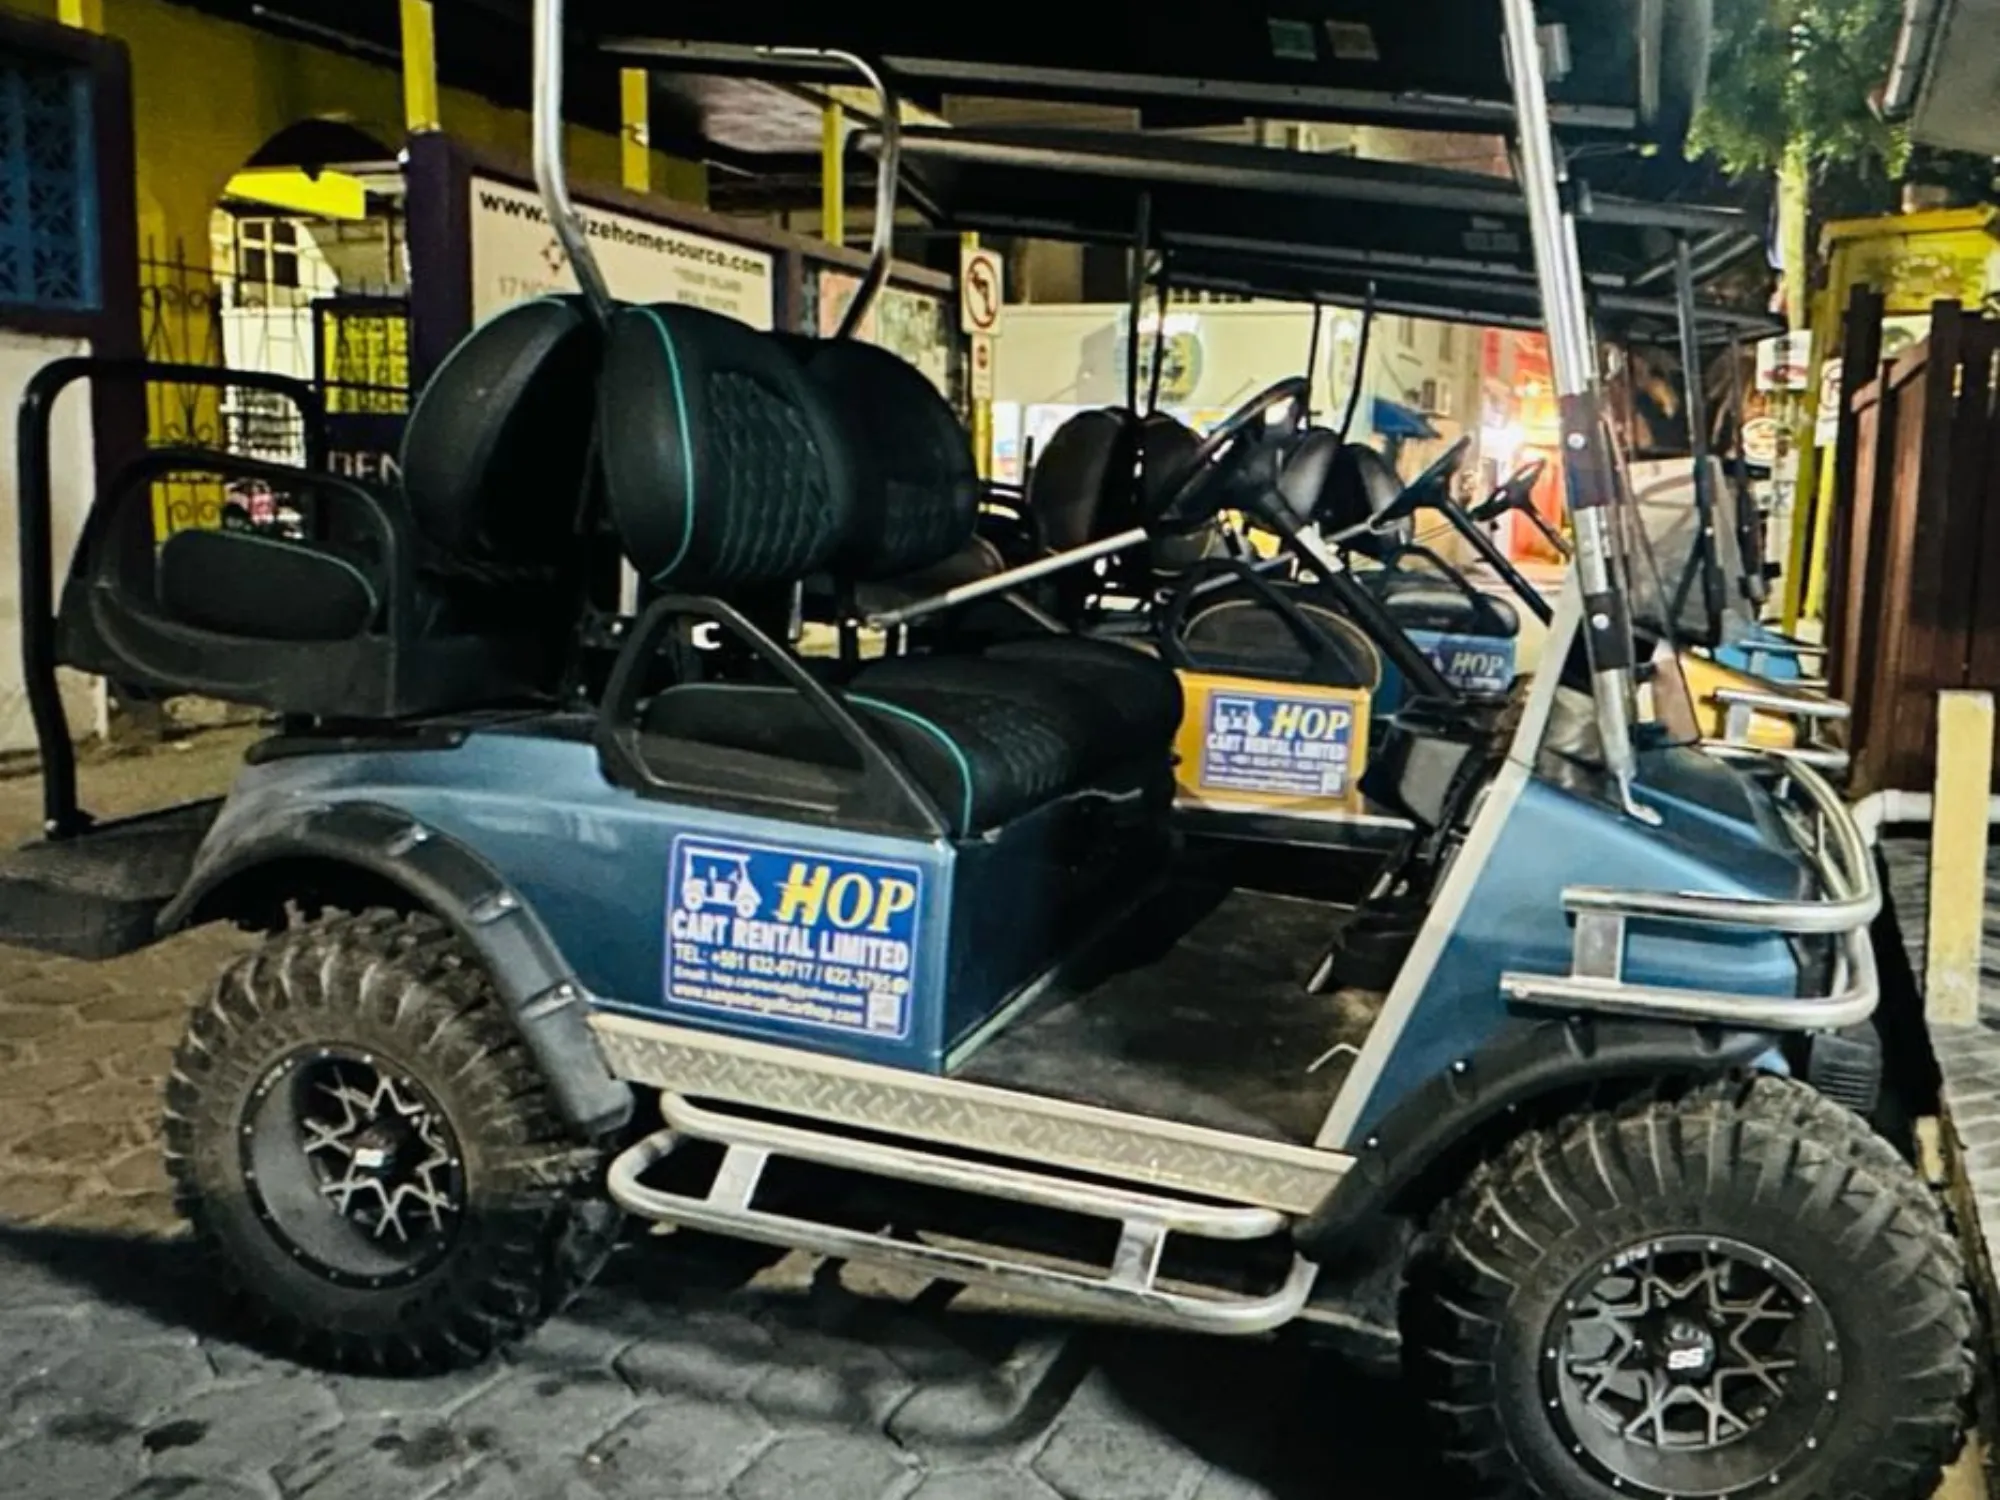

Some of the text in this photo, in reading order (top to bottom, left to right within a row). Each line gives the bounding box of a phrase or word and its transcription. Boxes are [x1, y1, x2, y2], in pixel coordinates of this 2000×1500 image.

[1451, 651, 1505, 677] HOP
[1270, 703, 1349, 741] HOP
[775, 862, 915, 932] HOP
[672, 908, 909, 973] CART RENTAL LIMITED
